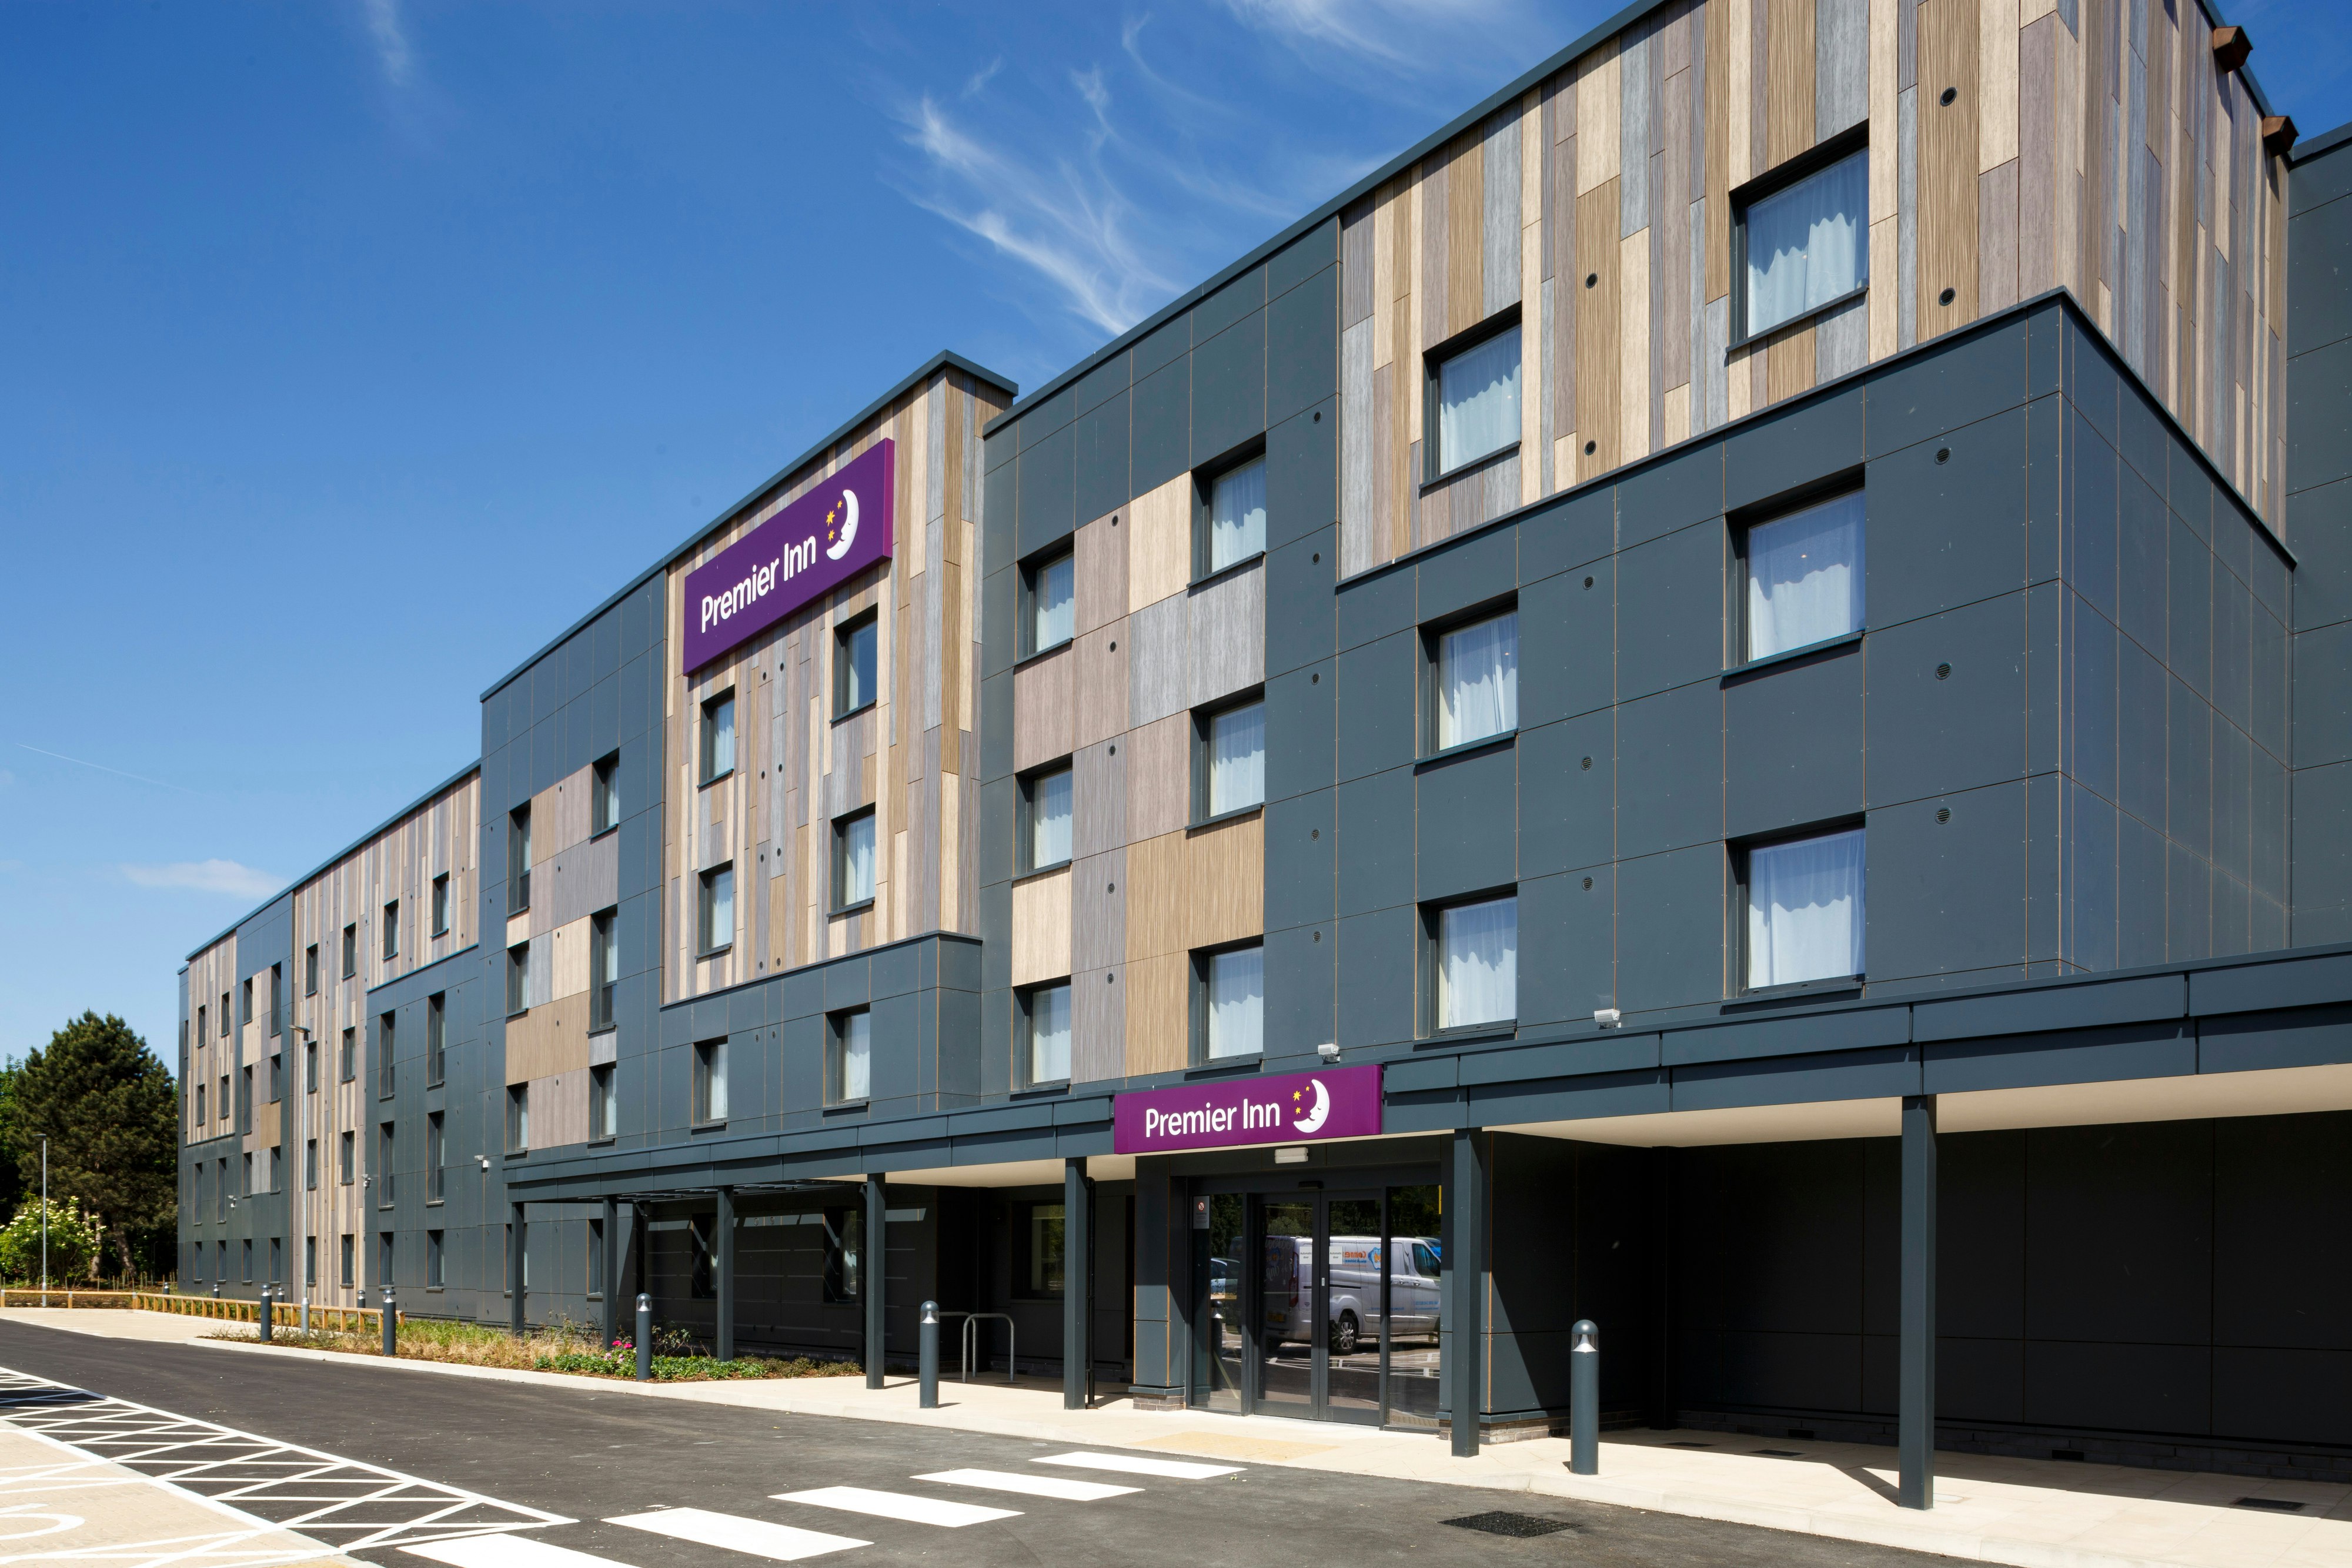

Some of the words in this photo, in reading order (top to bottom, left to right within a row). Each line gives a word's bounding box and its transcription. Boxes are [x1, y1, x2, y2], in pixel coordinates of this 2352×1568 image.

[701, 558, 779, 634] Premier
[784, 536, 816, 581] Inn
[1146, 1102, 1237, 1138] Premier
[1243, 1098, 1280, 1129] Inn
